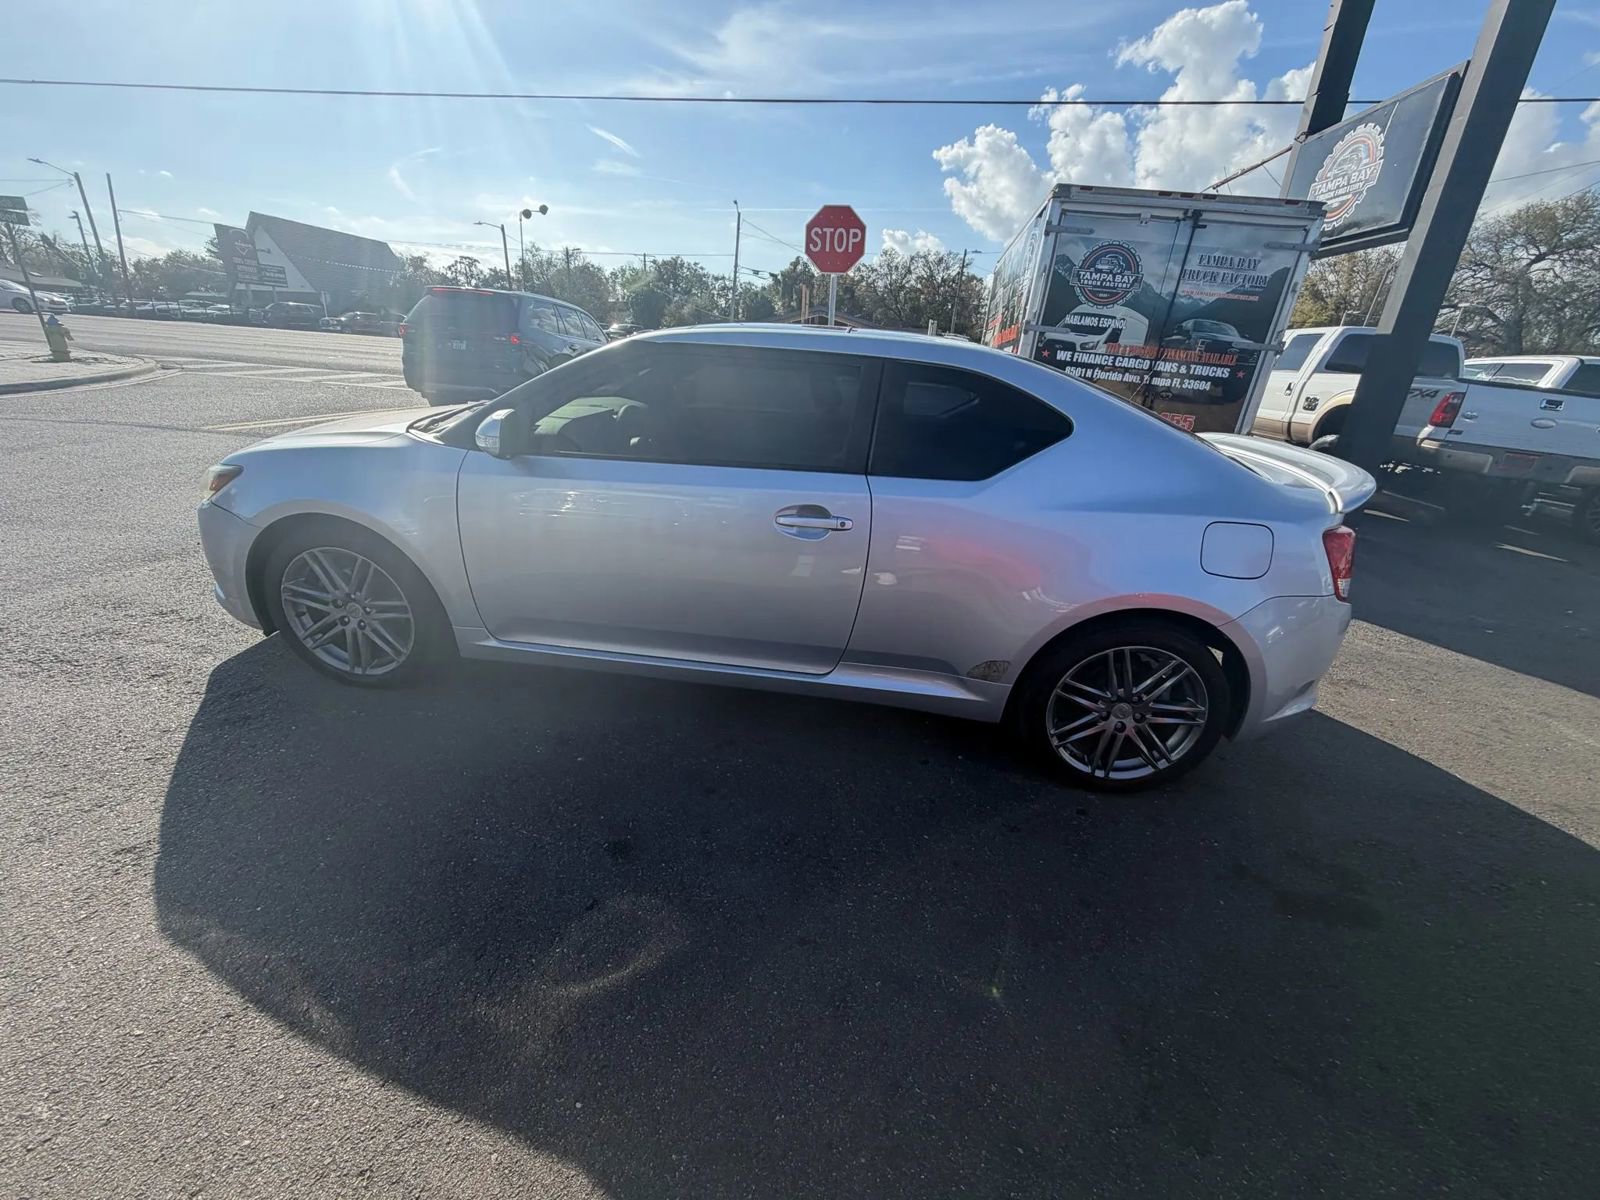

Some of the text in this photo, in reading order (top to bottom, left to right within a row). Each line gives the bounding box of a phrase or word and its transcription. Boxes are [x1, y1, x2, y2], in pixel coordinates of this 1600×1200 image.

[1313, 166, 1375, 197] TAMPA BAY
[810, 226, 862, 253] STOP
[1079, 271, 1136, 284] TAMPA BAY
[1081, 279, 1132, 289] TRUCK FACTORY
[1065, 313, 1099, 328] HABLAMOS
[1056, 349, 1231, 379] WE FINANCE CARGO VANS & TRUCKS
[1065, 366, 1085, 378] 8501
[1086, 368, 1094, 378] N
[1093, 368, 1122, 382] Florida
[1182, 379, 1212, 391] 33604
